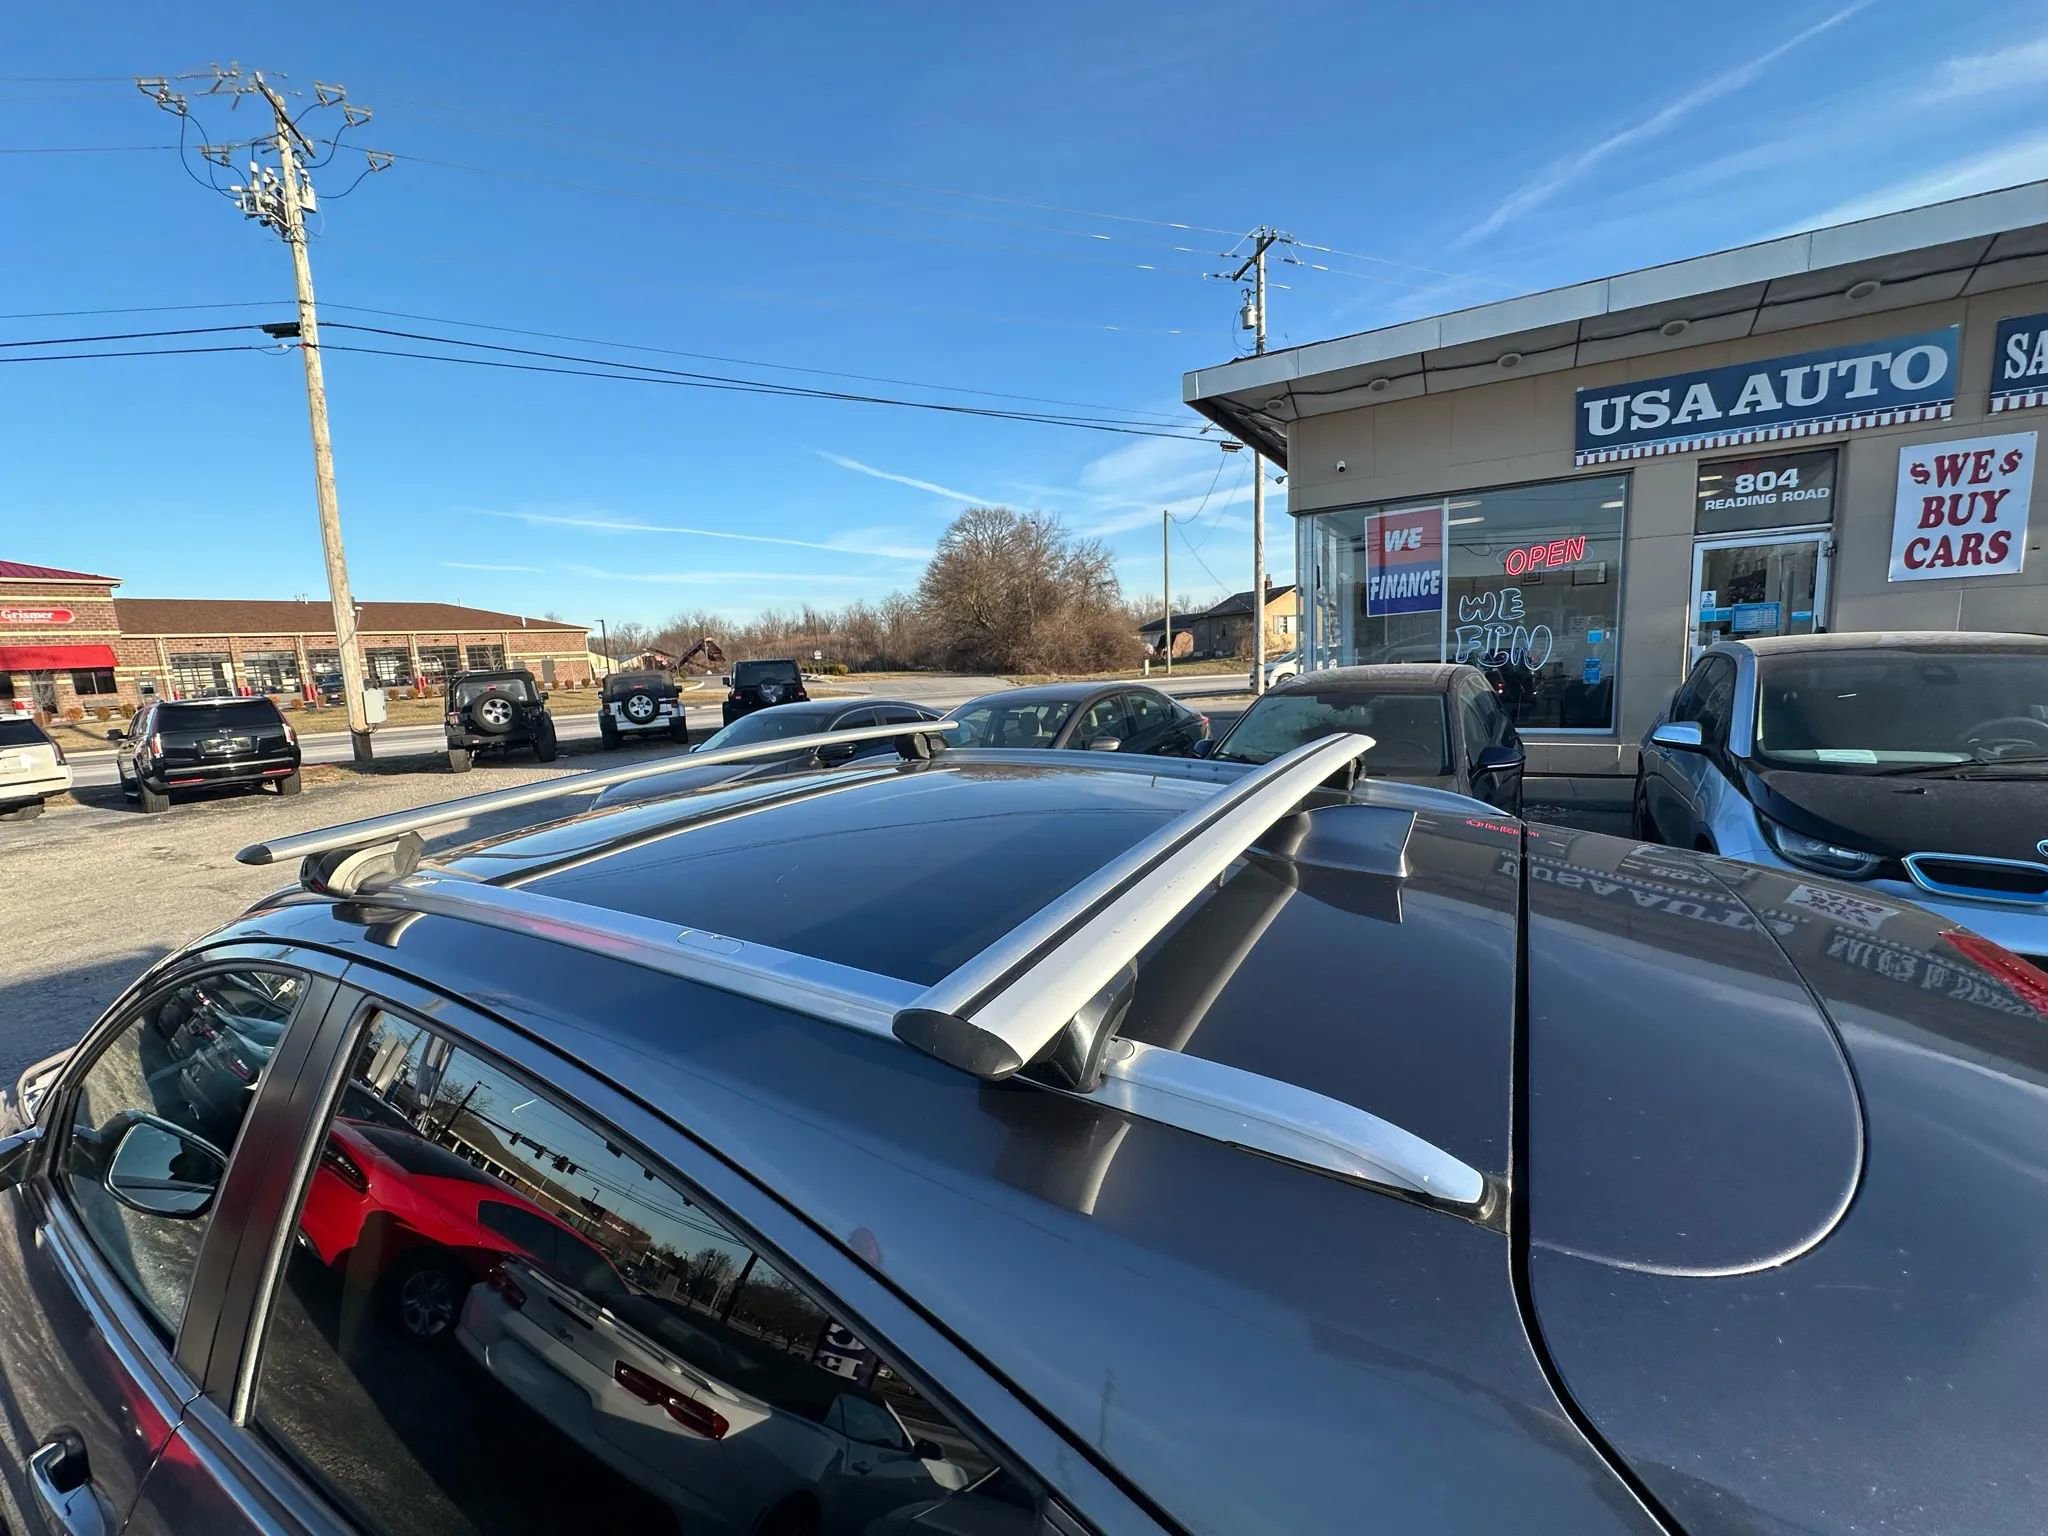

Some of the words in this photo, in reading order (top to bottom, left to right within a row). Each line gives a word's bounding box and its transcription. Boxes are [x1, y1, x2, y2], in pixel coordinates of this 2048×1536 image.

[1584, 383, 1723, 437] USA
[1729, 345, 1948, 417] AUTO
[1735, 468, 1799, 493] 804
[1705, 493, 1777, 511] READING
[1781, 487, 1829, 503] ROAD
[1917, 489, 2011, 529] BUY
[1384, 526, 1424, 552] WE
[1506, 536, 1585, 575] OPEN
[1904, 530, 2011, 570] CARS
[1370, 569, 1441, 601] FINANCE
[1, 609, 54, 619] Grismer
[1459, 588, 1525, 622] WE
